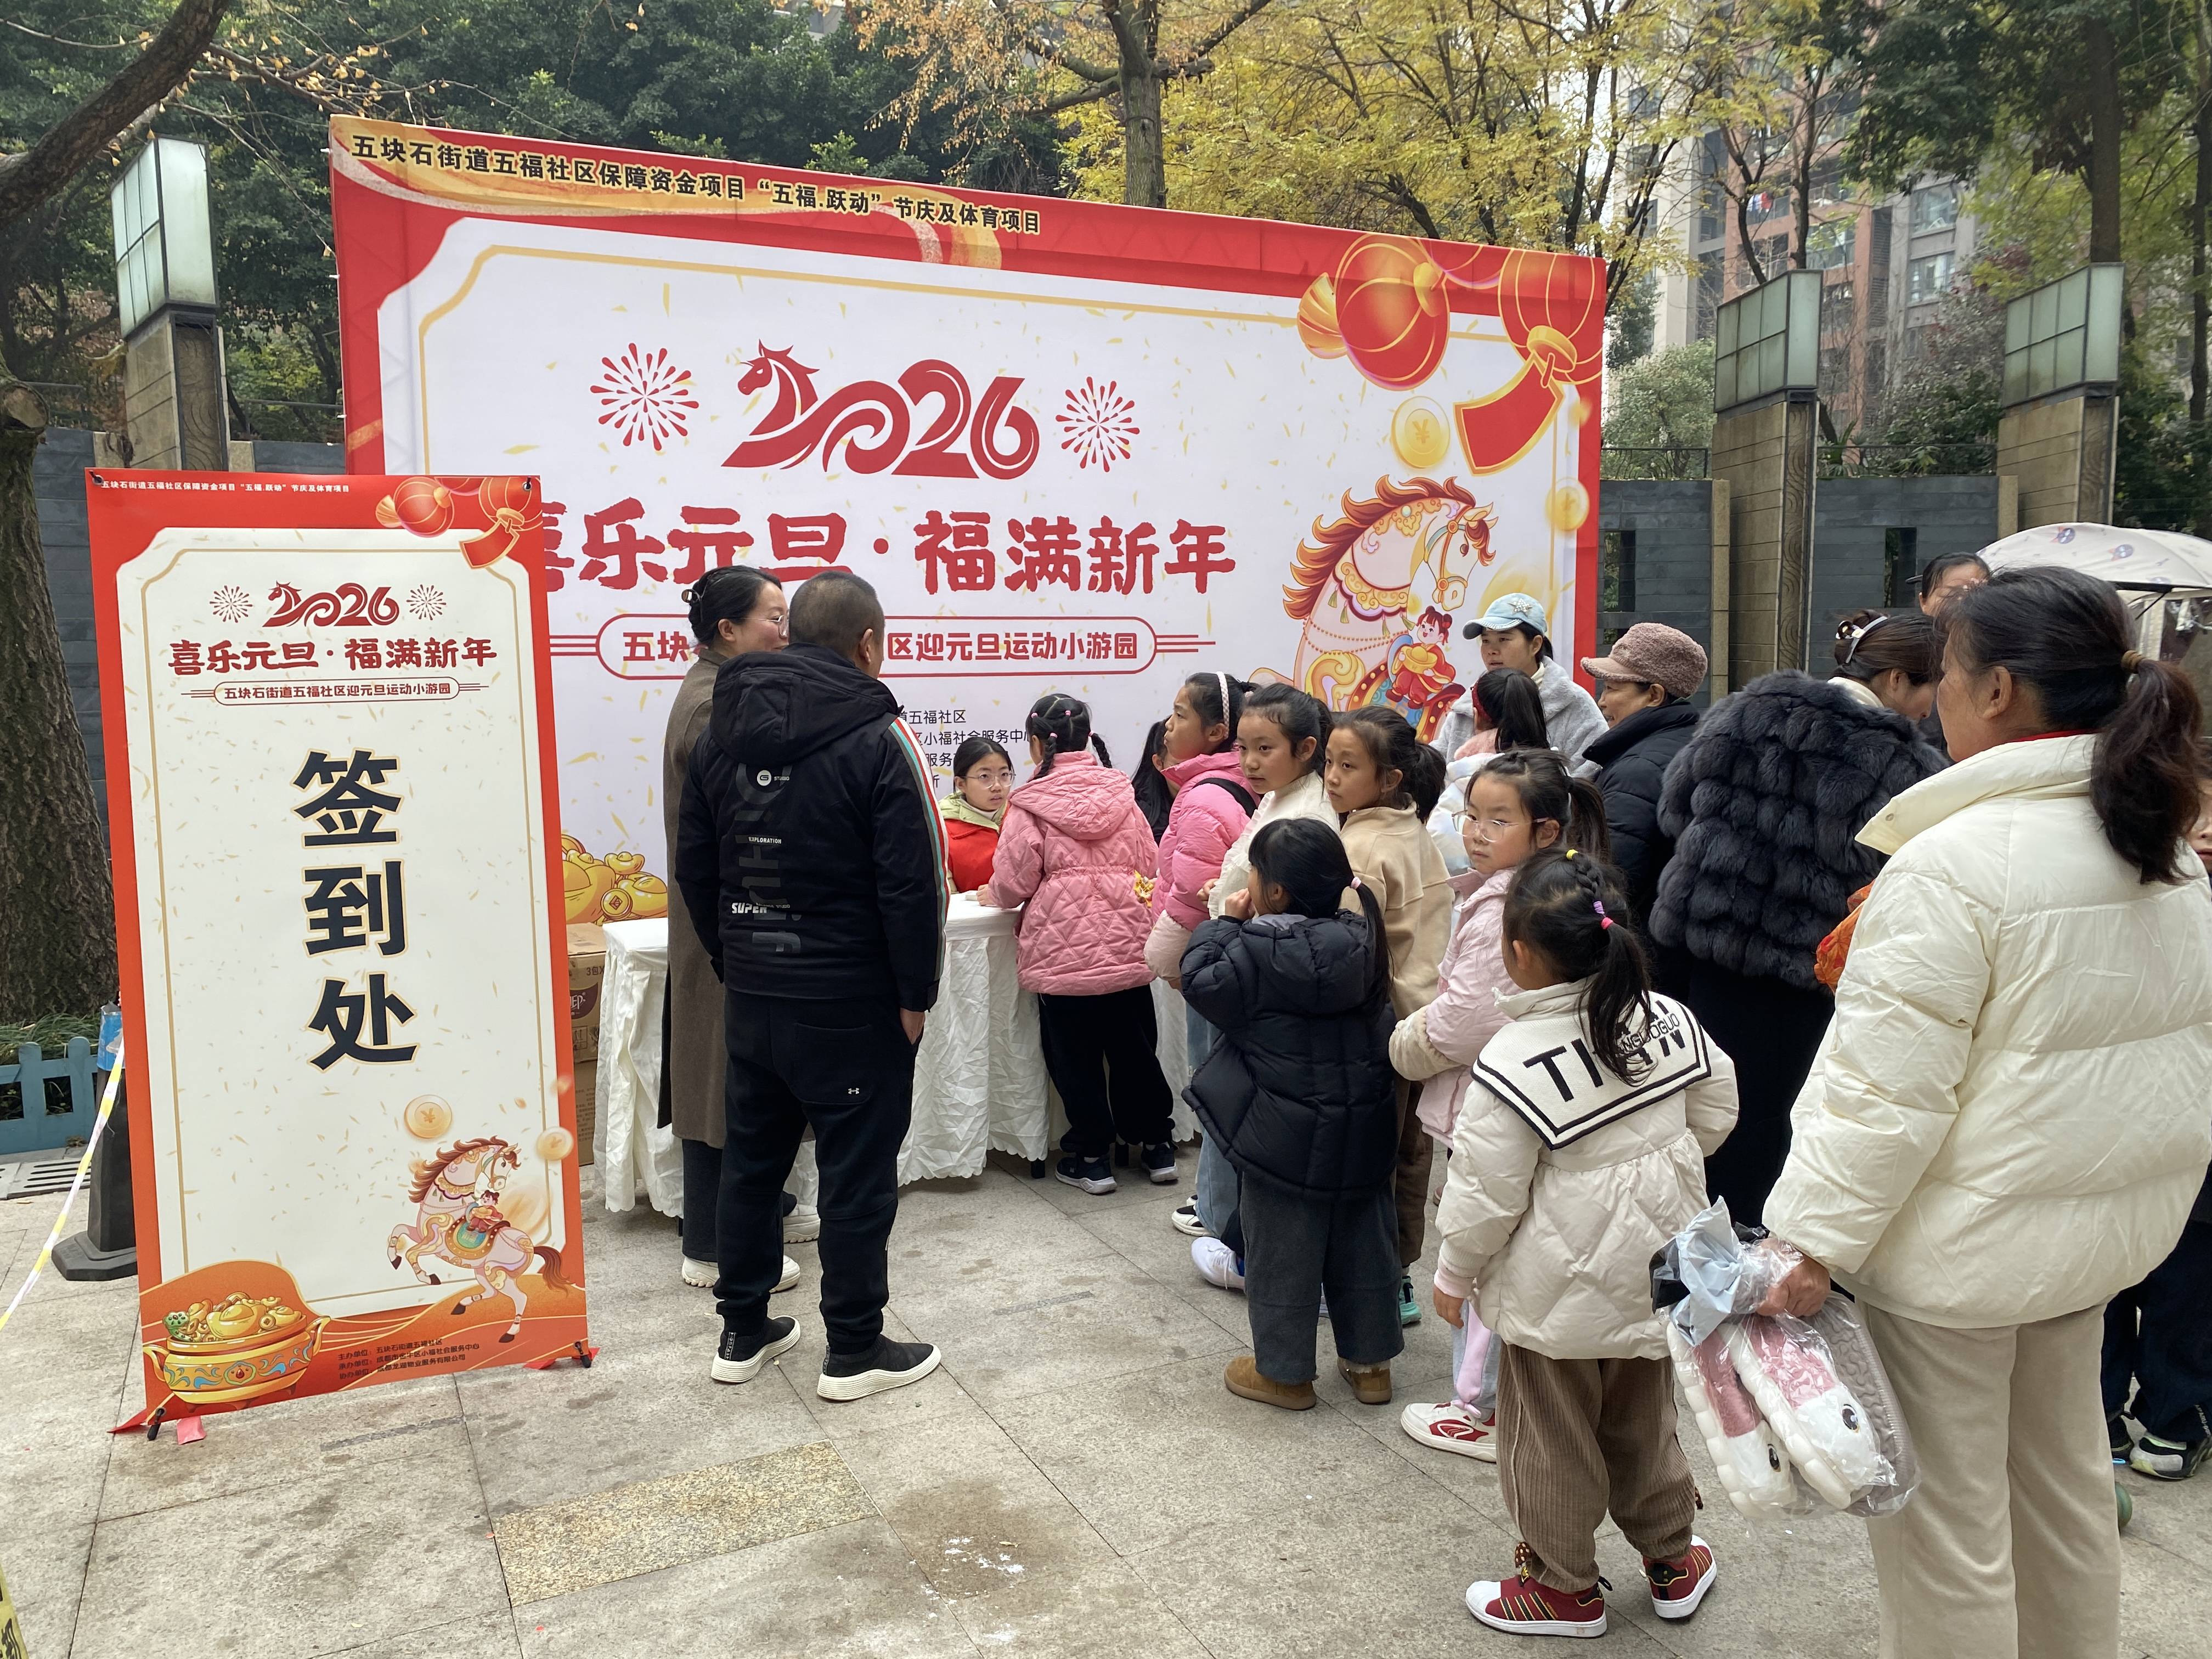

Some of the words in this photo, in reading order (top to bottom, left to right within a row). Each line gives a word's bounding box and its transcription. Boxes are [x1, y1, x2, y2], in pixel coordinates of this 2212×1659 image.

[224, 682, 452, 700] 五块石街道五福社区迎元旦运动小游园
[748, 836, 782, 844] EXPLORATION
[293, 749, 418, 1071] 签到处
[731, 902, 768, 914] SUPER
